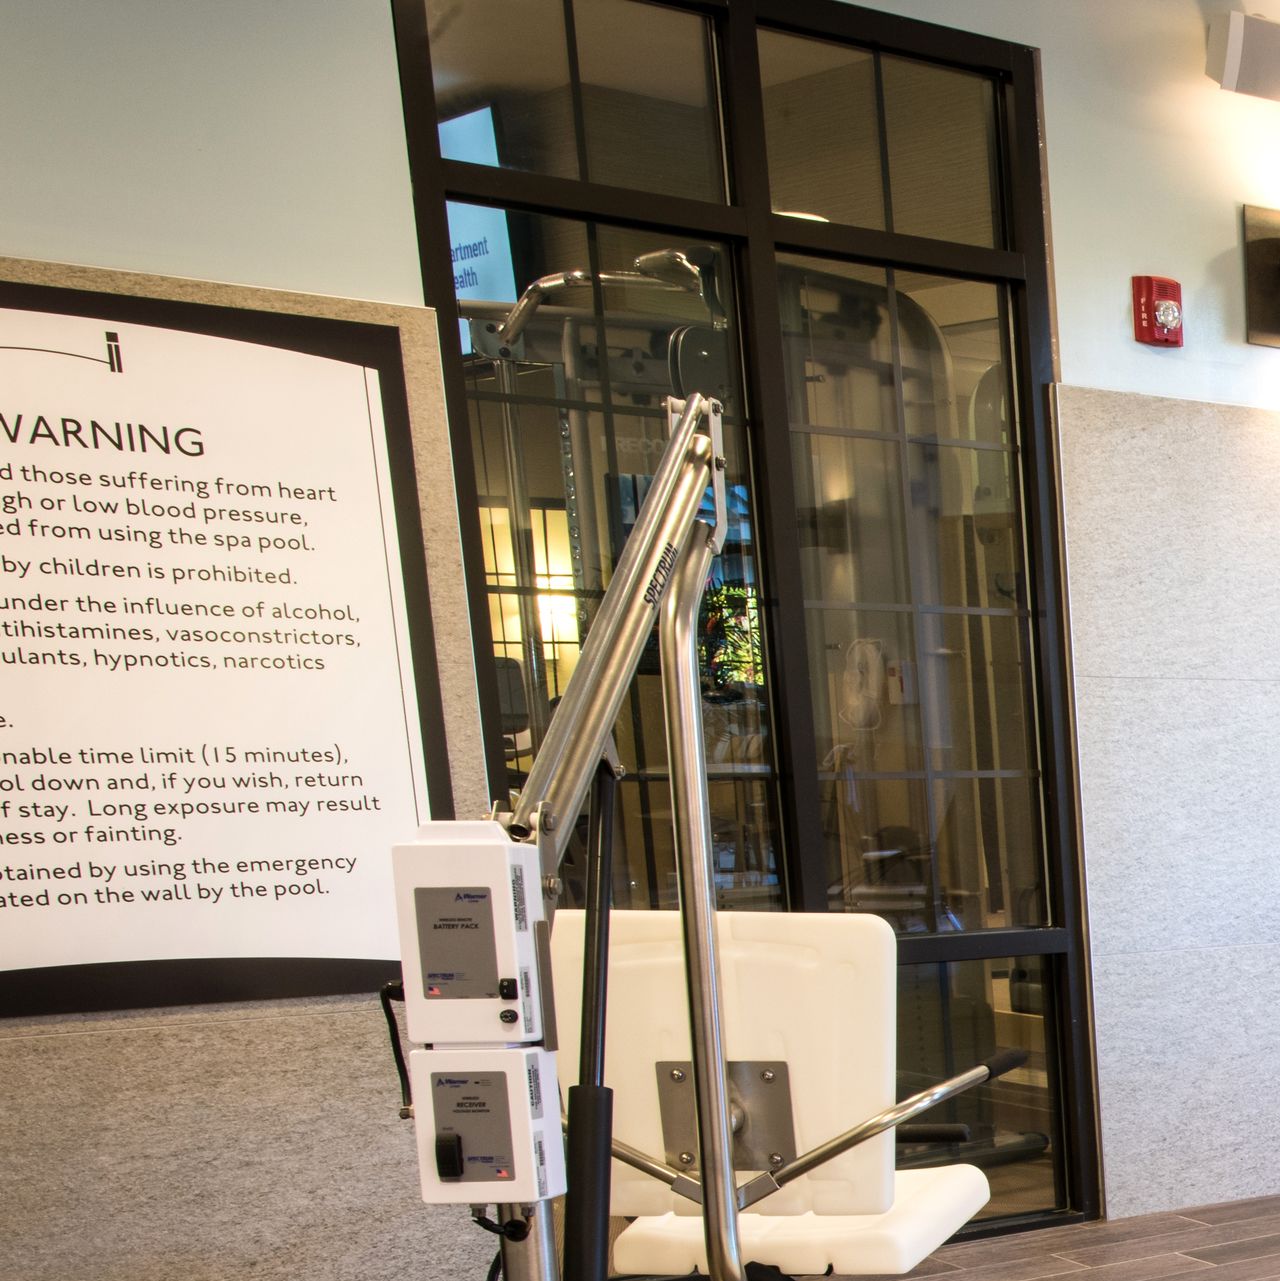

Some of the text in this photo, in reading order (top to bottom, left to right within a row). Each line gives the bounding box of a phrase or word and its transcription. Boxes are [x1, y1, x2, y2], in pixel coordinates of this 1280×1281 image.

[1140, 297, 1148, 327] FIRE
[19, 464, 93, 486] those
[98, 470, 210, 500] suffering
[214, 476, 272, 498] from
[277, 481, 338, 502] heart
[1, 490, 308, 527] gh or low blood pressure,
[27, 518, 92, 540] from
[98, 524, 163, 550] using
[167, 527, 208, 546] the
[213, 534, 252, 552] spa
[258, 533, 317, 554] pool.
[1, 554, 299, 585] by children is prohibited.
[643, 542, 678, 609] SPECTRUM
[74, 594, 117, 614] the
[122, 596, 235, 618] influence
[241, 601, 265, 618] of
[271, 602, 360, 623] alcohol,
[1, 619, 361, 648] tihistamines, vasoconstrictors,
[1, 646, 326, 672] ulants, hypnotics, narcotics
[2, 746, 73, 765] nable
[77, 747, 135, 765] time
[139, 746, 196, 764] limit
[244, 743, 348, 766] minutes),
[31, 773, 100, 792] down
[107, 772, 156, 792] and,
[161, 771, 177, 790] if
[182, 776, 226, 795] you
[231, 771, 289, 790] wish,
[294, 772, 364, 788] return
[18, 802, 76, 823] stay.
[87, 799, 149, 822] Long
[153, 801, 260, 820] exposure
[265, 800, 310, 818] may
[316, 794, 382, 812] result
[0, 824, 183, 847] ess or fainting.
[0, 857, 357, 883] tained by using the emergency
[57, 892, 89, 906] on
[93, 886, 135, 904] the
[140, 883, 192, 902] wall
[196, 882, 224, 904] by
[229, 881, 268, 898] the
[273, 878, 330, 901] pool.
